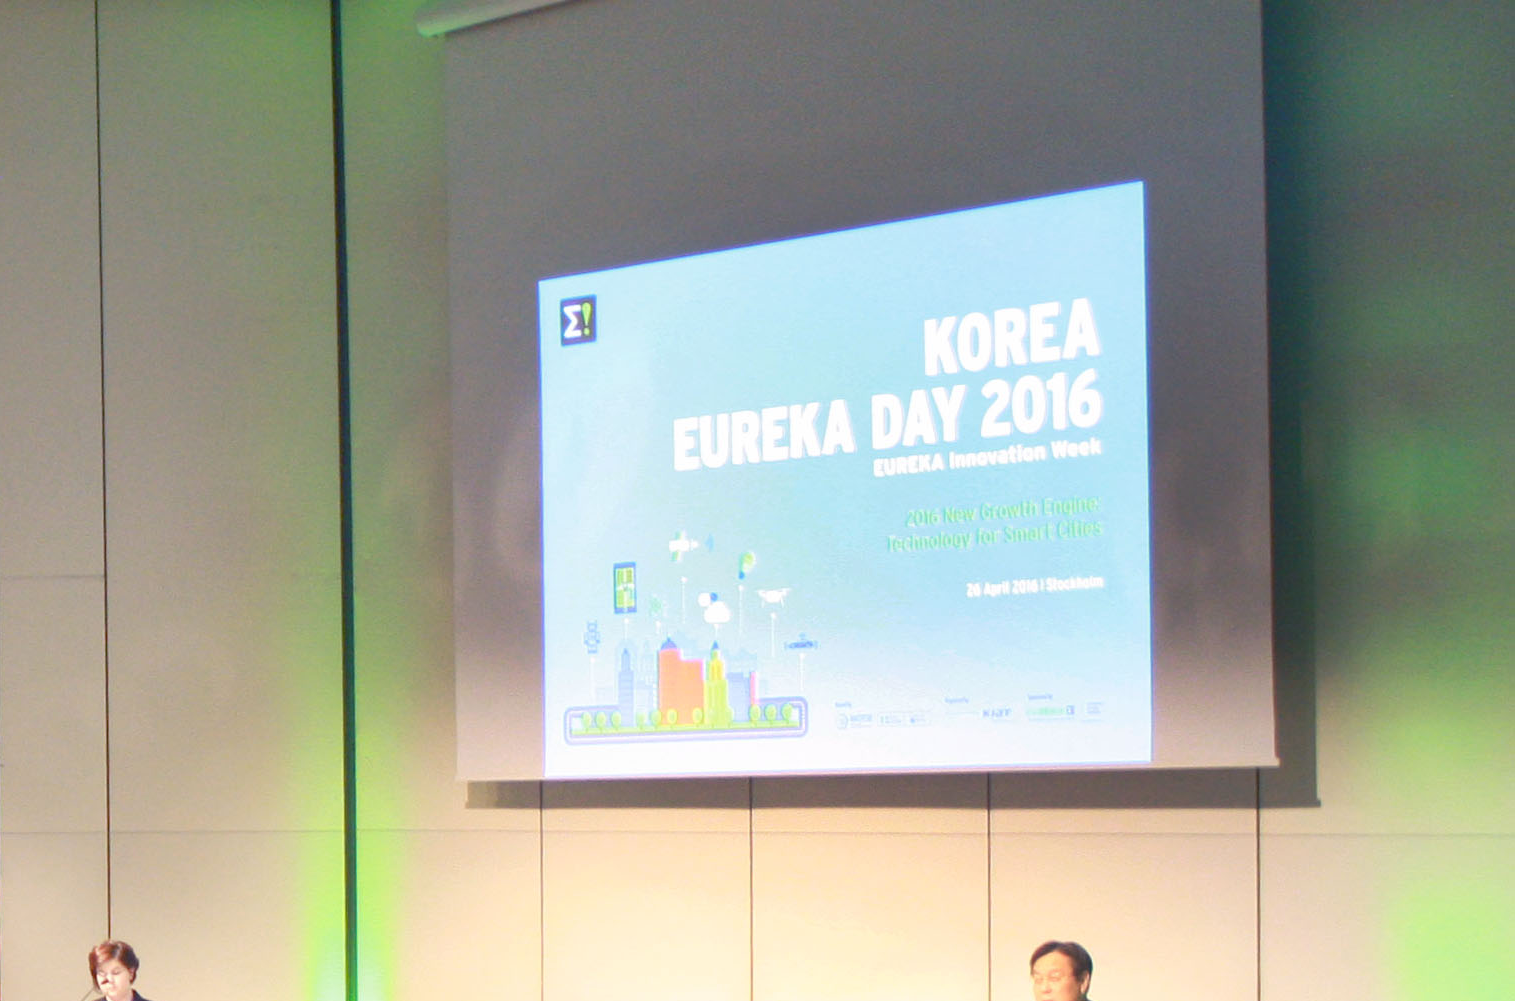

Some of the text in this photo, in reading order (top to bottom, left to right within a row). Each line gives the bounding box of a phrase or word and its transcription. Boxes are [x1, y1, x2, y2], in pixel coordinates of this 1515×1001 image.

[924, 298, 1101, 376] KOREA
[673, 368, 1103, 472] EUREKA DAY 2016
[873, 437, 1102, 478] EUREKA Innovation Week
[905, 496, 1102, 528] 2016 New Growth Engine:
[886, 518, 1103, 552] Technology for Smart Cities
[983, 580, 1010, 598] April
[1012, 578, 1039, 595] 2016
[1046, 575, 1105, 593] Stockholm
